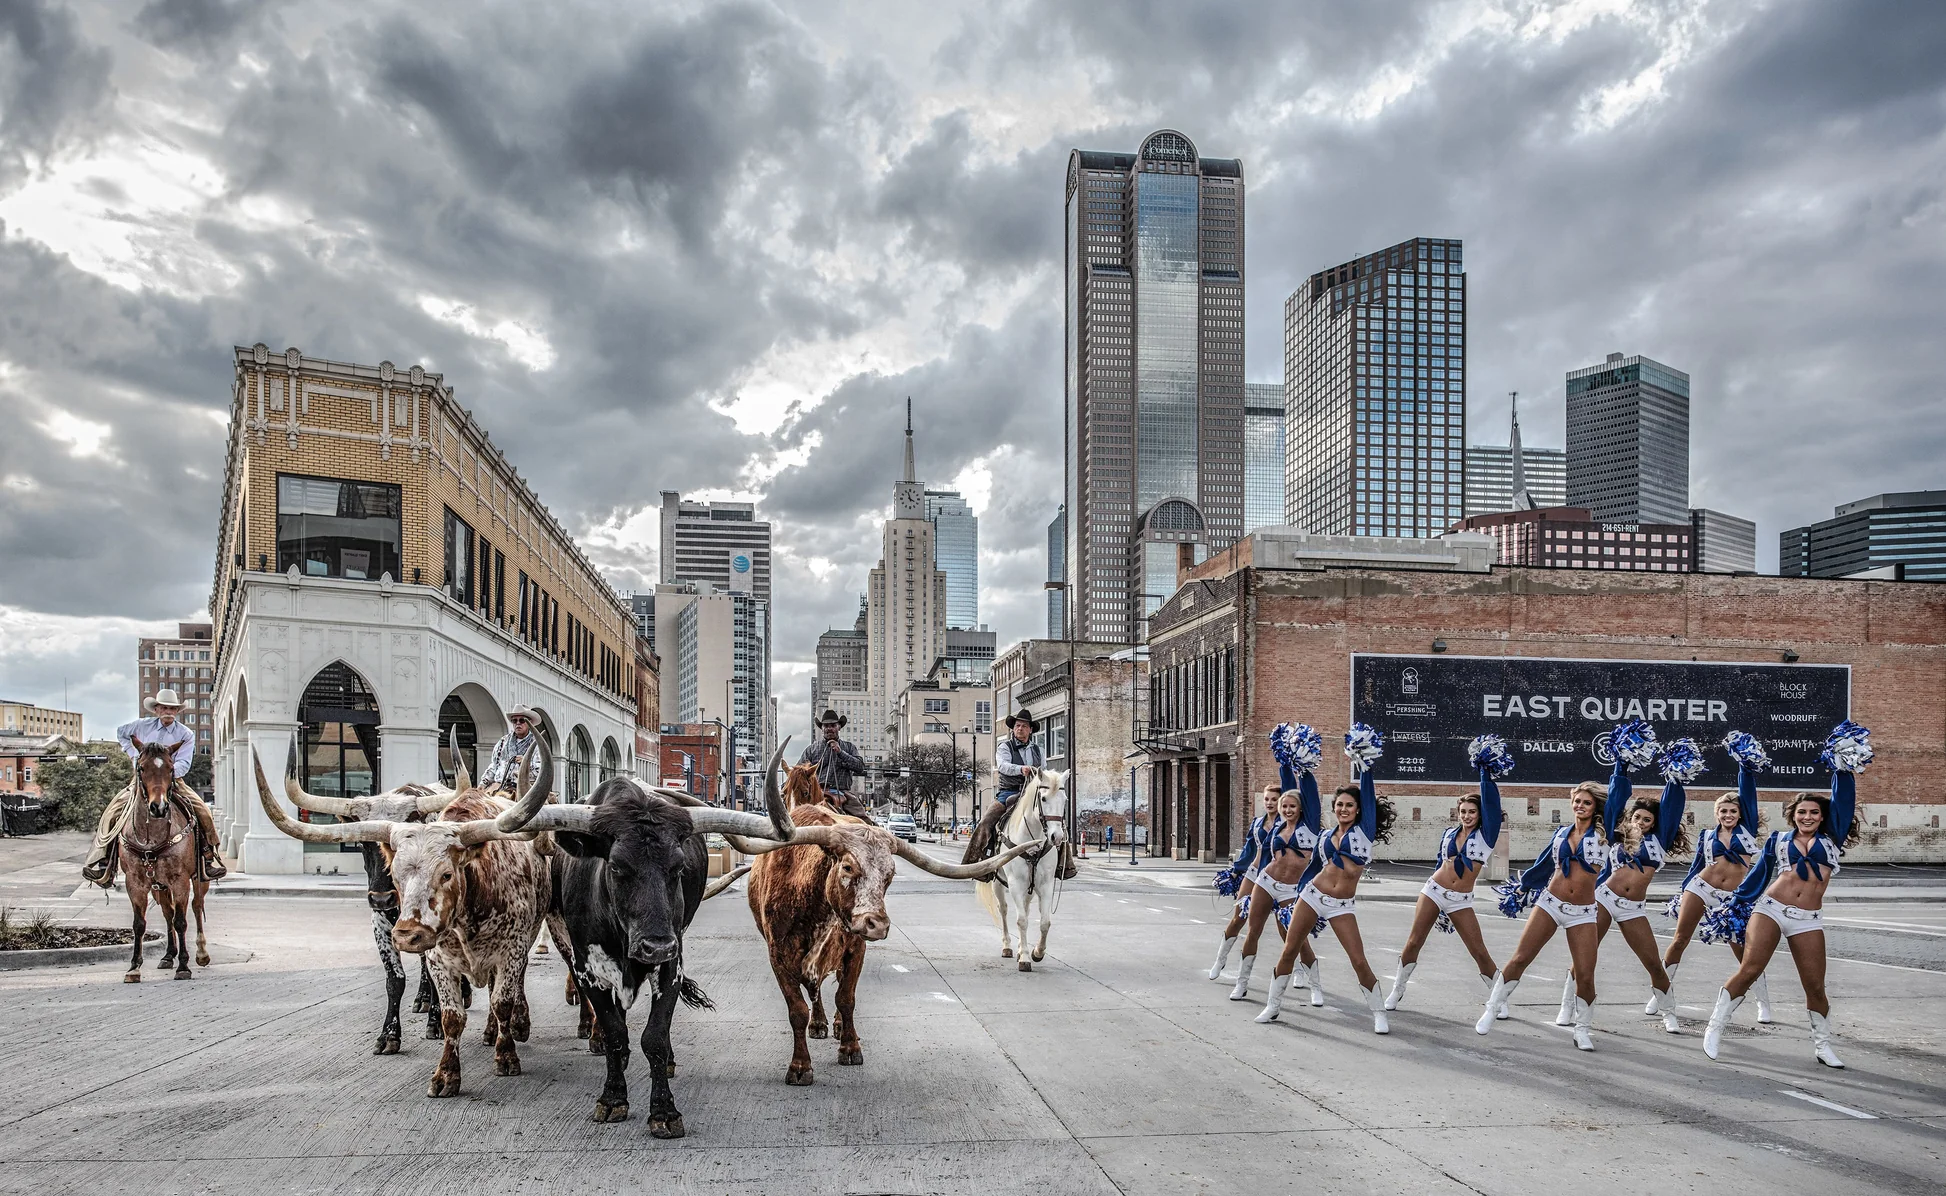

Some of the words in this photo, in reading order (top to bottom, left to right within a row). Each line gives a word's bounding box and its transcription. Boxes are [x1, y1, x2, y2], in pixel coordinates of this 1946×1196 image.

[1780, 683, 1807, 691] BLOCK
[1483, 694, 1571, 719] EAST
[1580, 697, 1728, 722] QUARTER
[1770, 714, 1818, 722] WOODRUFF
[1396, 733, 1427, 741] WATERS
[1523, 743, 1574, 753] DALLAS
[1772, 740, 1815, 751] JUANITA
[1772, 766, 1815, 774] MELETIO
